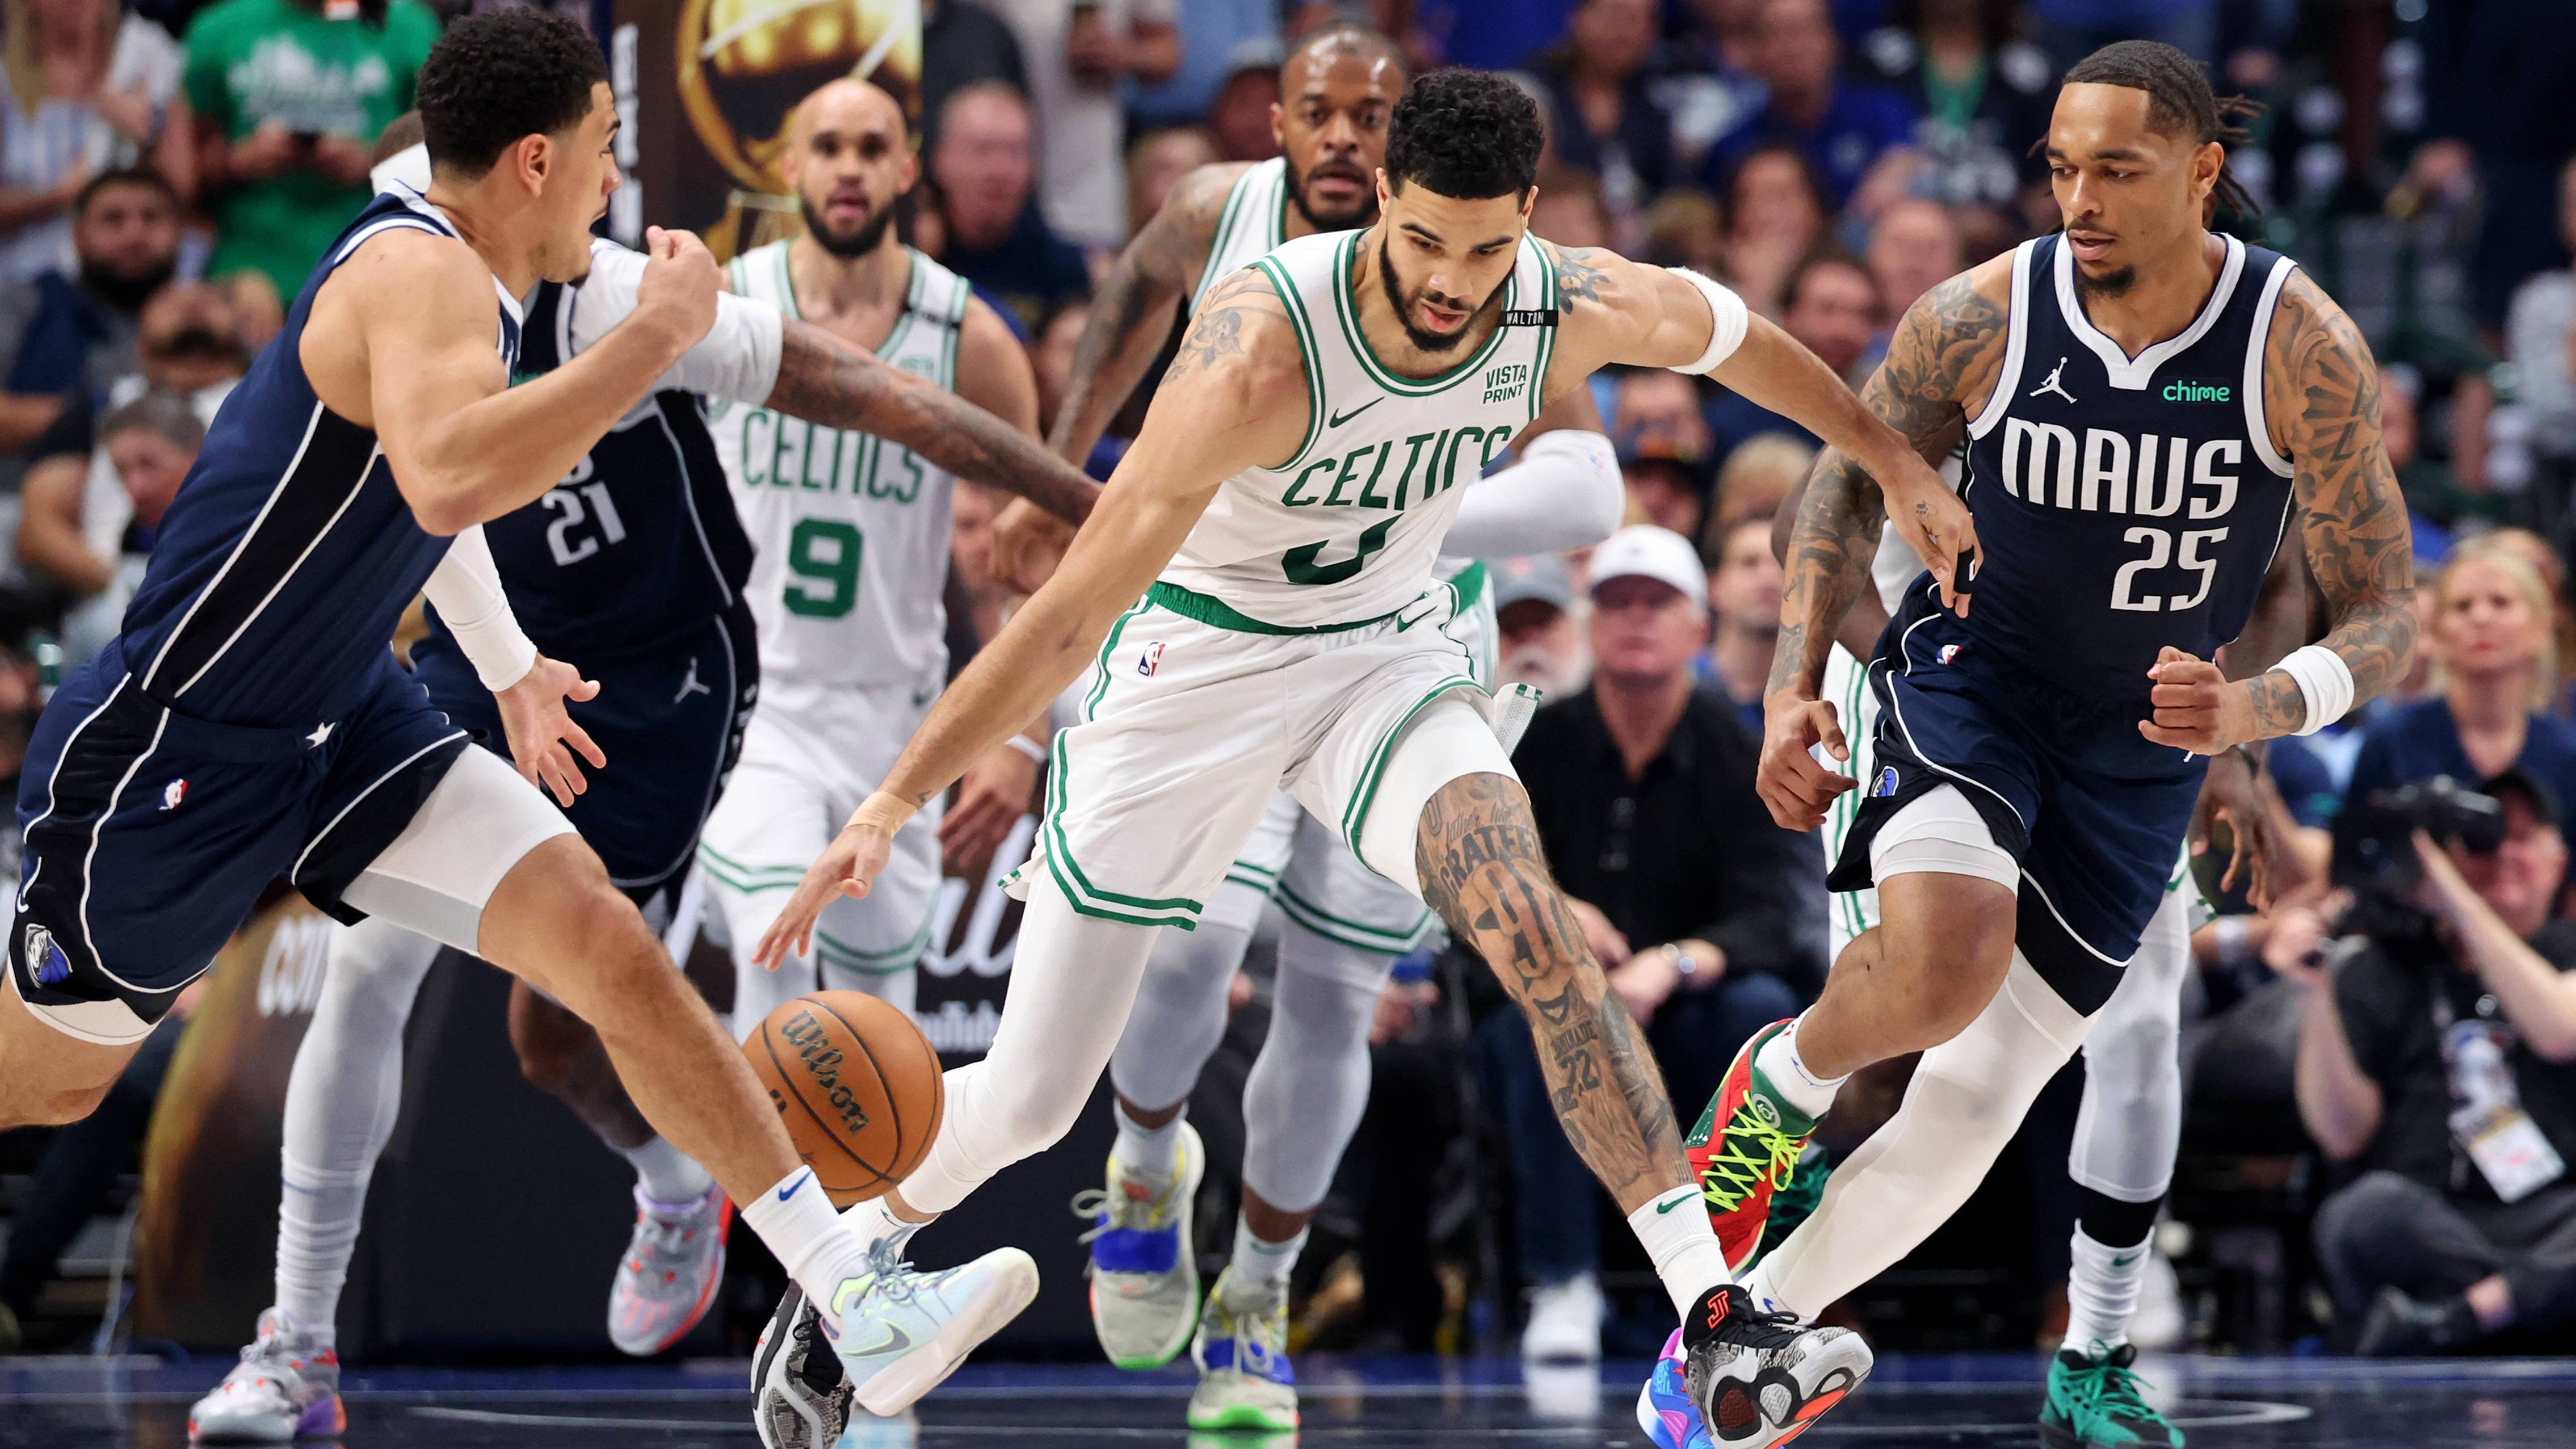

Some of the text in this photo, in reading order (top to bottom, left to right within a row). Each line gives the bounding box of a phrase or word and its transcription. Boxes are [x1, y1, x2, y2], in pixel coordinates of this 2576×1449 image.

[1506, 312, 1544, 325] WALTON
[1482, 383, 1526, 405] PRINT
[1486, 364, 1527, 389] VISTA
[2162, 380, 2230, 402] chime
[2002, 416, 2242, 519] MAVS
[541, 480, 627, 567] 21
[782, 517, 863, 619] 9
[2110, 526, 2230, 611] 25
[781, 1008, 869, 1136] Wilson
